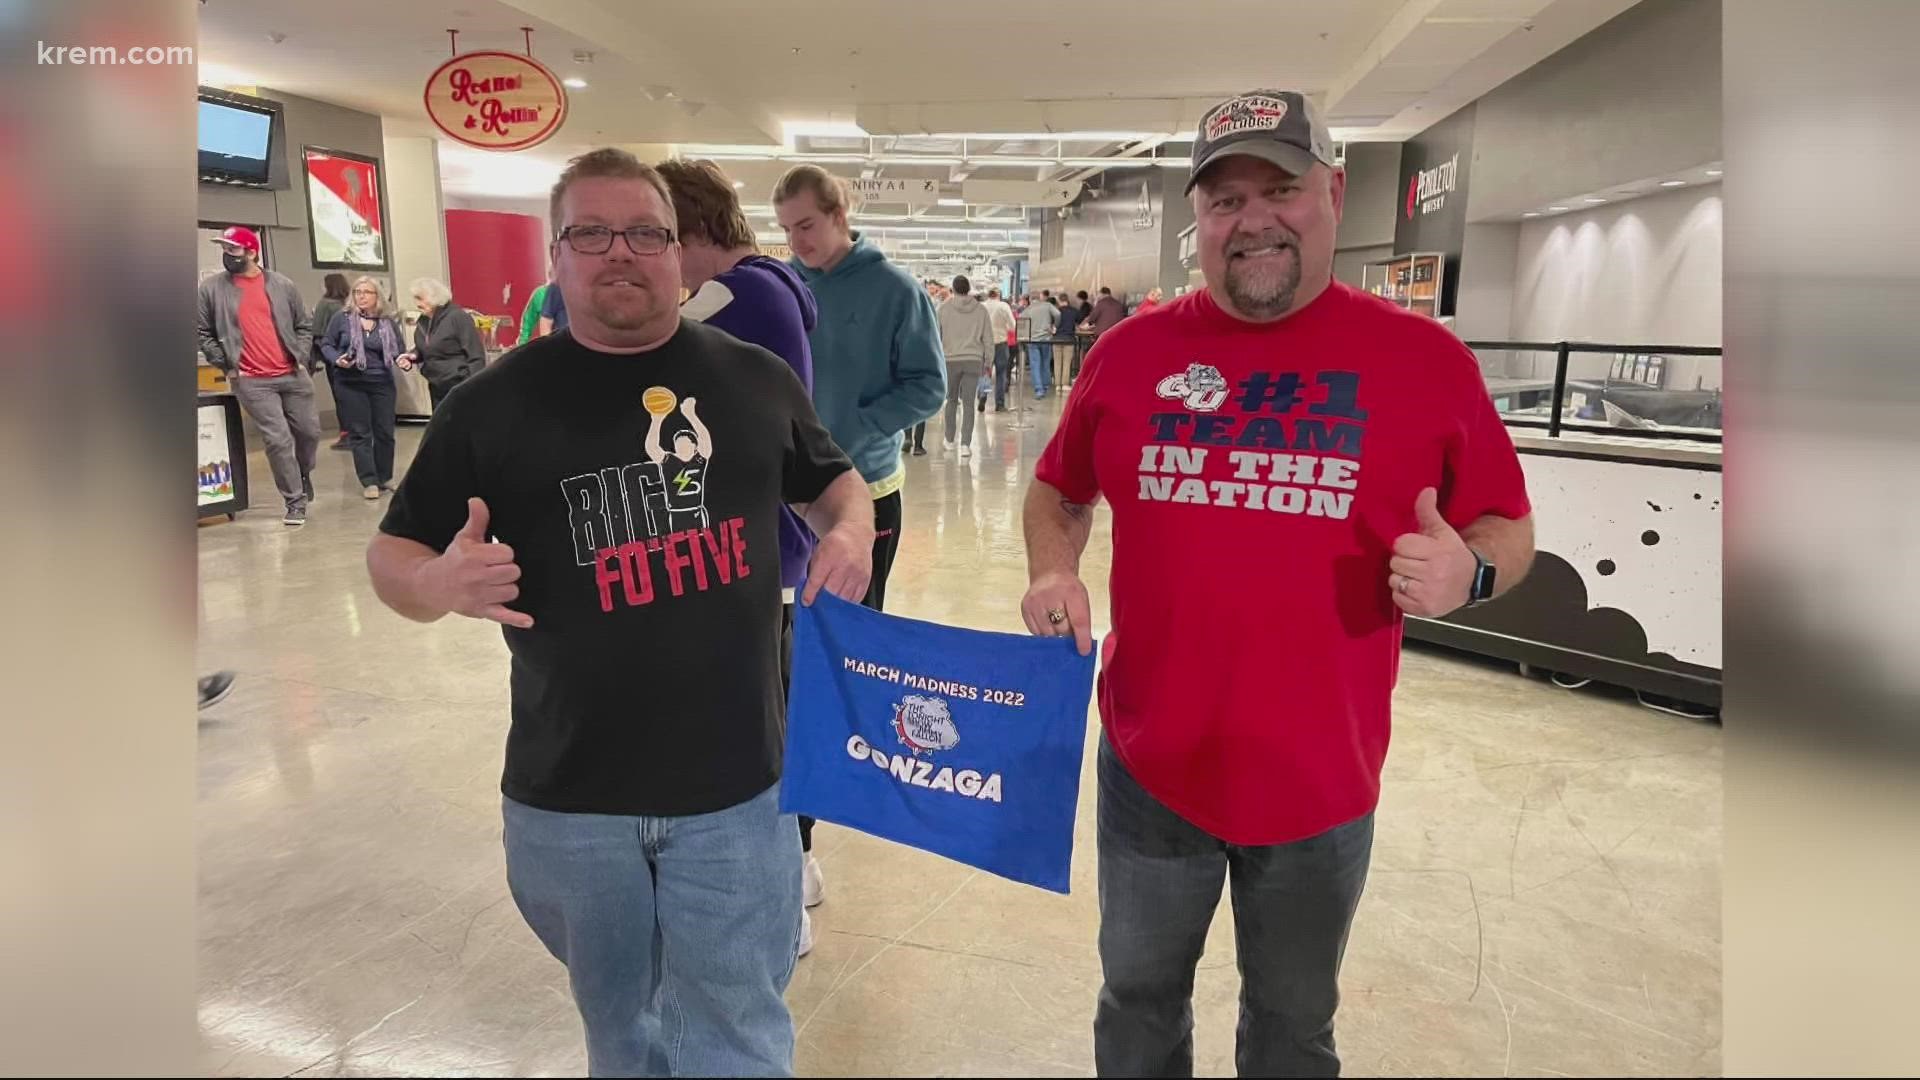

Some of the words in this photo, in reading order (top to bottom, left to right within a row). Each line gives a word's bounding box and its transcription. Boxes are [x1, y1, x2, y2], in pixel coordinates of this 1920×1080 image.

[1214, 97, 1280, 122] GONZAGA
[1416, 152, 1460, 206] PENDLETON
[1234, 370, 1369, 421] #1
[1150, 412, 1368, 456] TEAM
[1138, 446, 1208, 475] IN
[1228, 451, 1360, 488] THE
[560, 461, 671, 566] BIG
[1138, 475, 1354, 520] NATION
[844, 657, 900, 684] MARCH
[903, 672, 978, 700] MADNESS
[982, 689, 1025, 706] 2022
[846, 734, 1003, 802] GONZAGA
